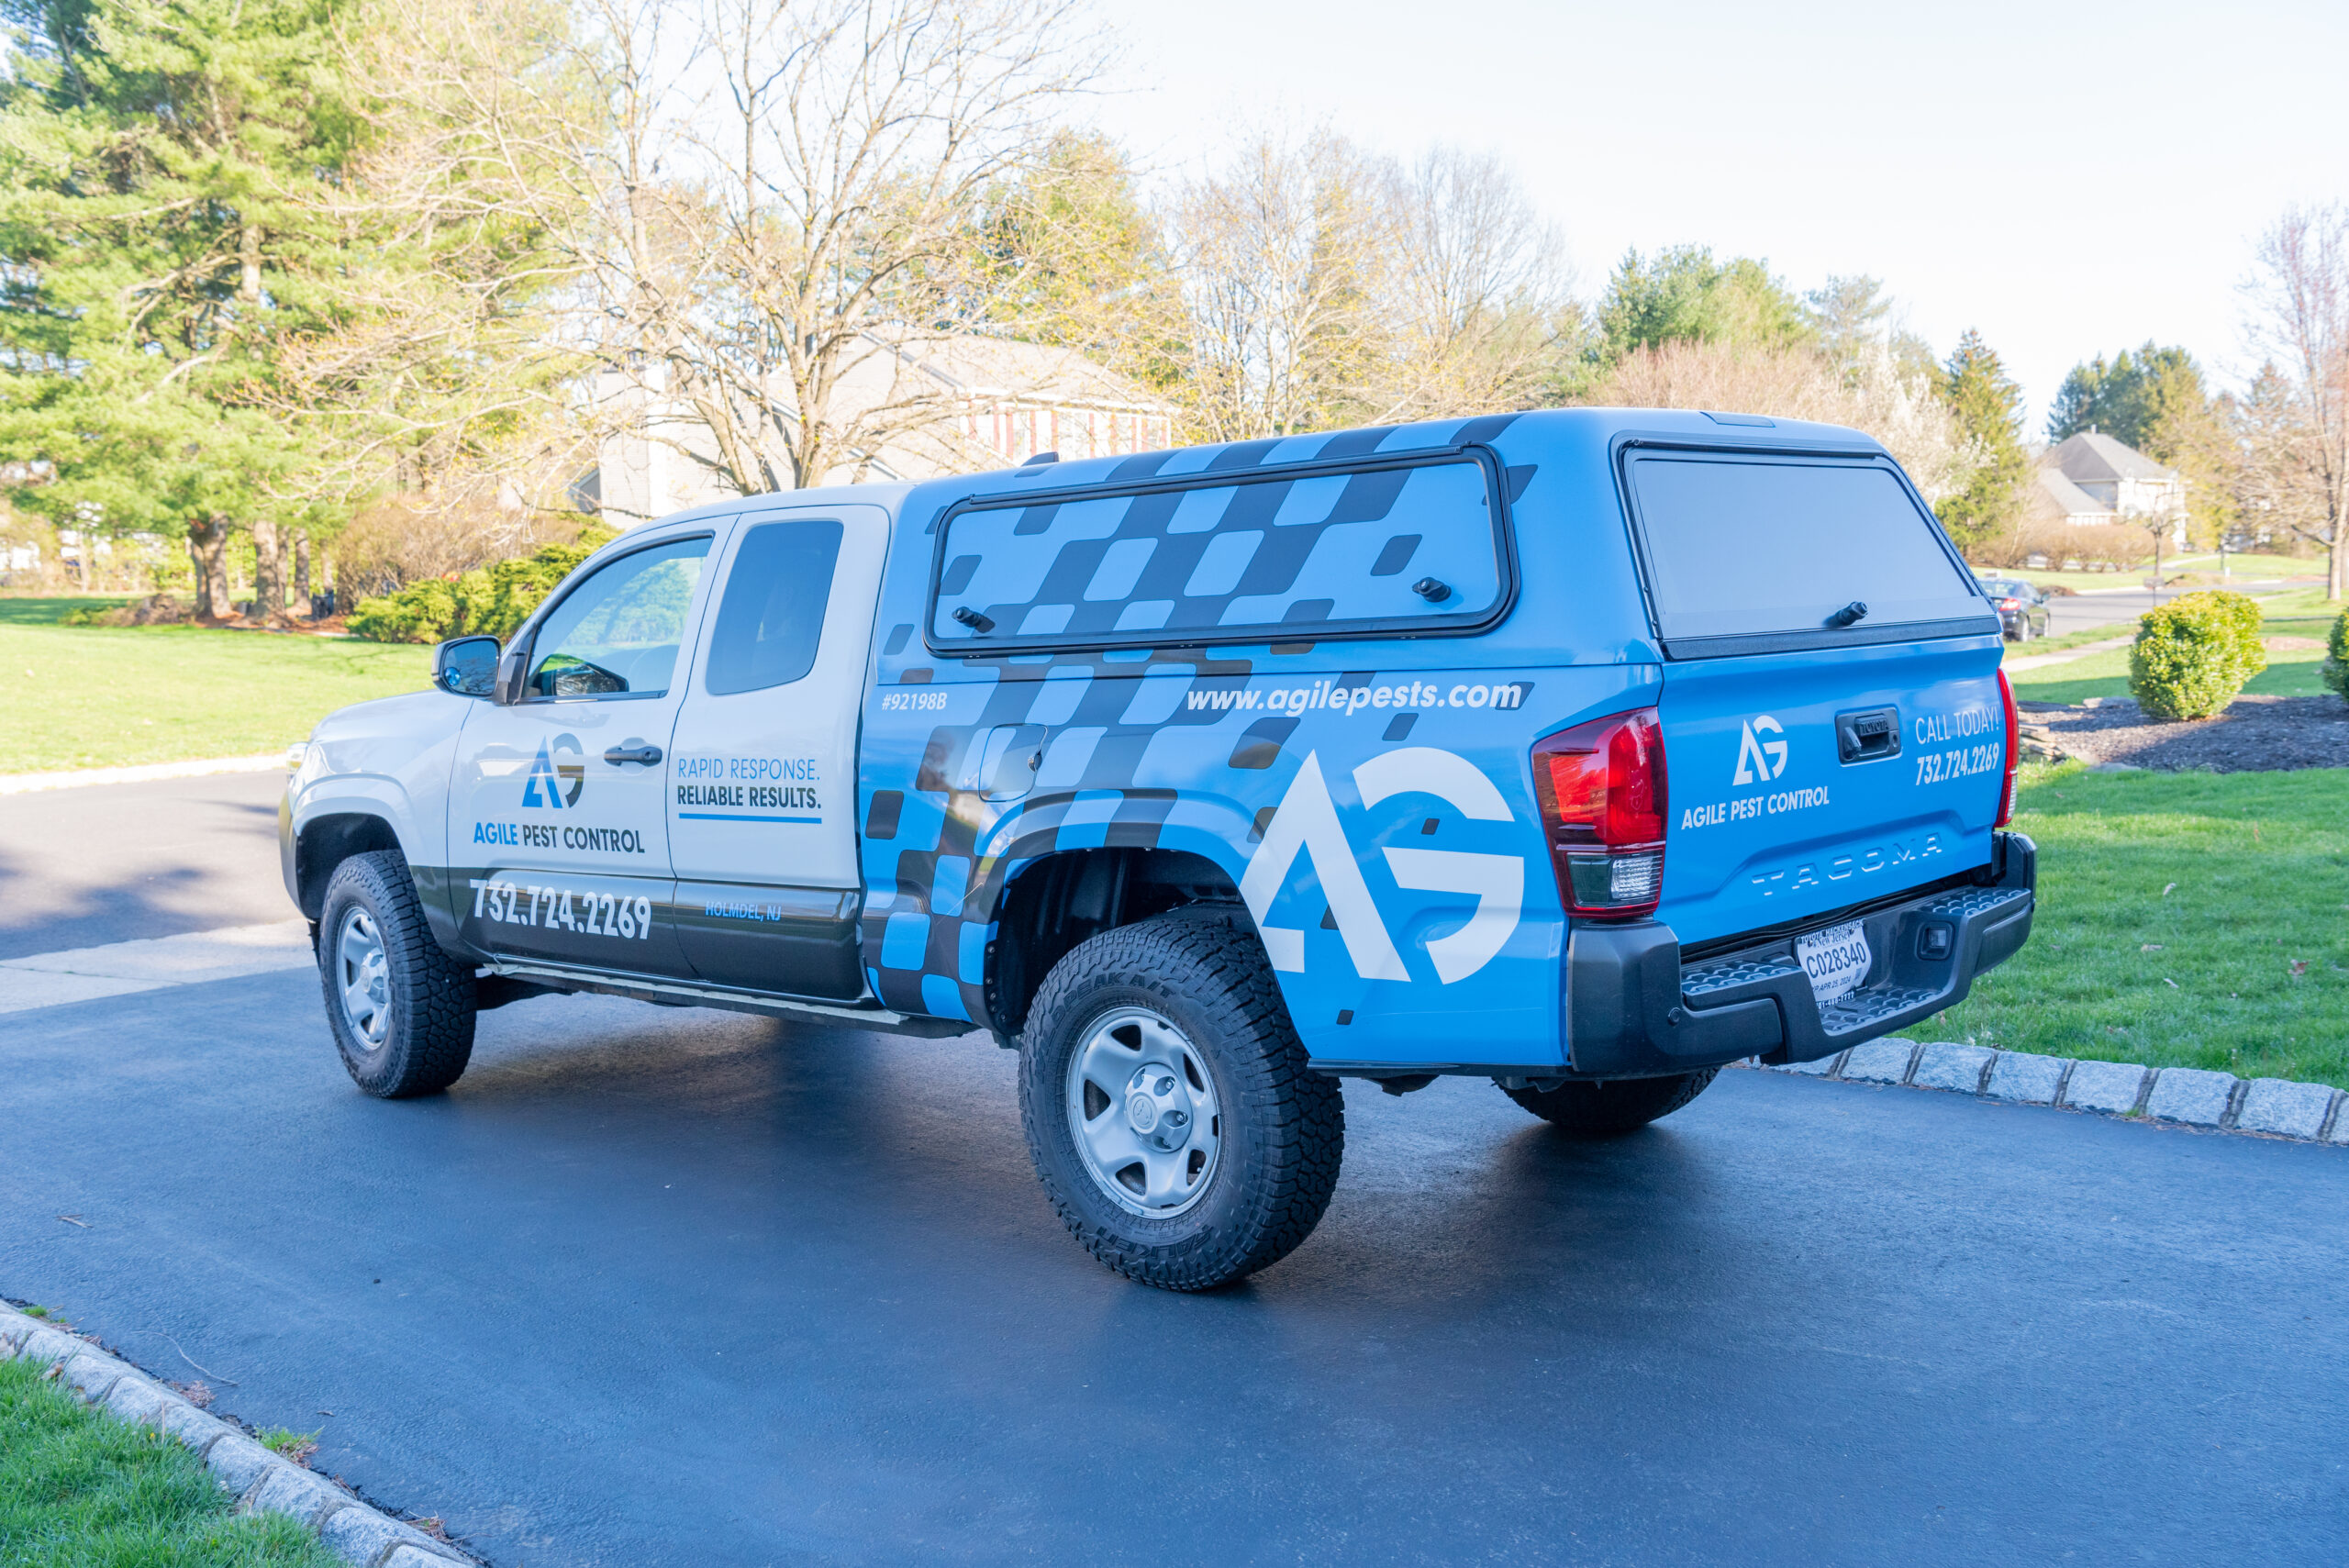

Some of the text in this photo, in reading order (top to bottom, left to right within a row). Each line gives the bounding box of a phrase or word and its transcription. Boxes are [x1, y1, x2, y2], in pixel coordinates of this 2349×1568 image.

[882, 692, 948, 711] #92198B
[1188, 680, 1521, 717] www.agilepests.com
[1860, 719, 1889, 735] TOYOTA
[1915, 706, 1999, 745] CALL TODAY!
[678, 758, 821, 781] RAPID RESPONSE.
[1915, 741, 2000, 786] 732.724.2269
[677, 784, 822, 809] RELIABLE RESULTS.
[1681, 785, 1830, 830] AGILE PEST CONTROL
[473, 821, 646, 854] AGILE PEST CONTROL
[1752, 832, 1943, 896] TACOMA
[469, 878, 652, 940] 732.724.2269
[706, 901, 781, 921] HOLMDEL, NJ
[1800, 930, 1823, 945] TOYOTA
